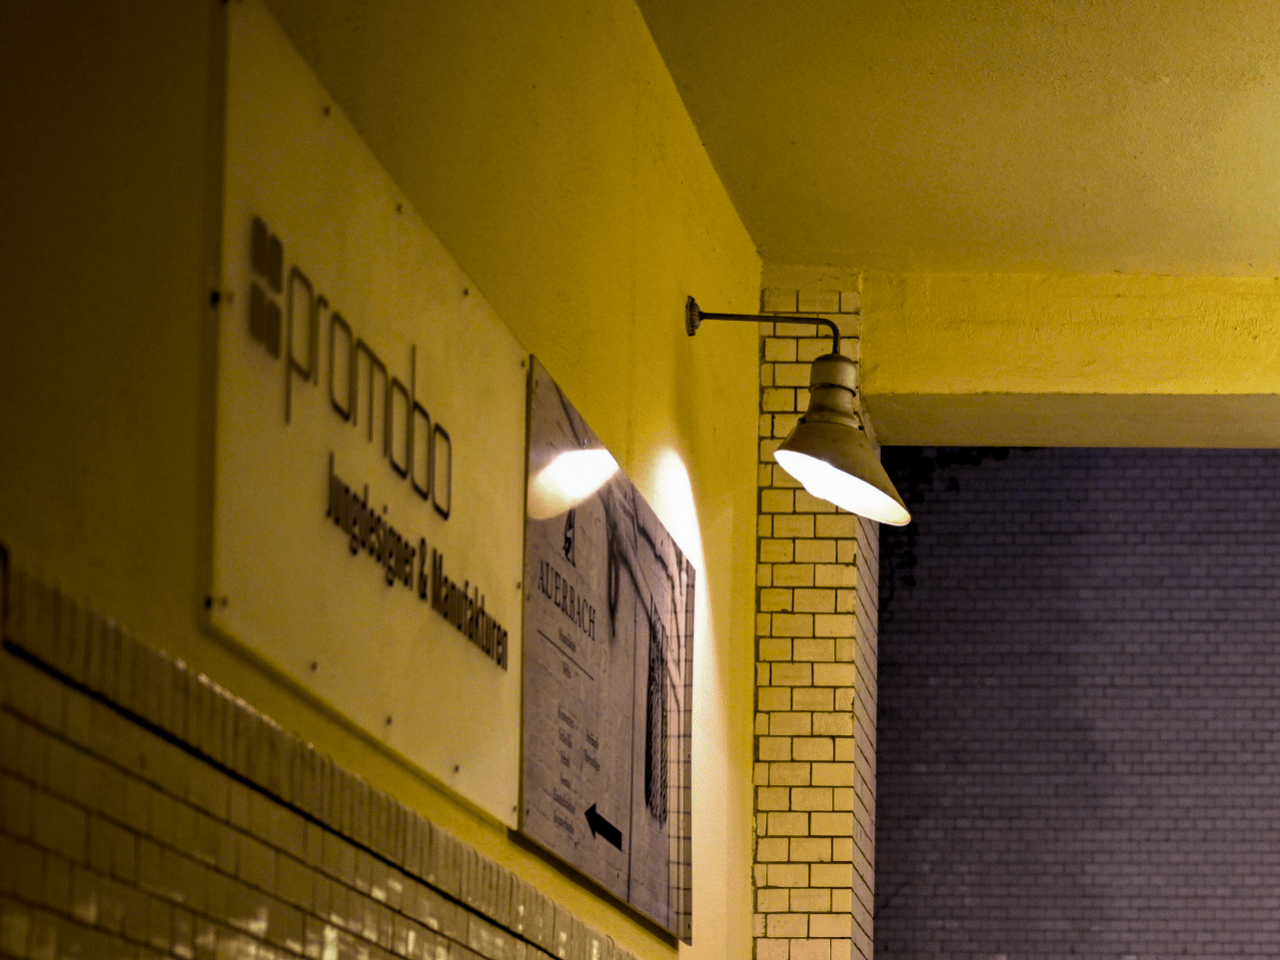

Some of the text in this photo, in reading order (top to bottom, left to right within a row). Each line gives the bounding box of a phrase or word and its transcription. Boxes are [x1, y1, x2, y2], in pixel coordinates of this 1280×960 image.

[284, 264, 452, 522] promobo
[418, 535, 428, 602] &
[537, 558, 597, 642] AUERBACH
